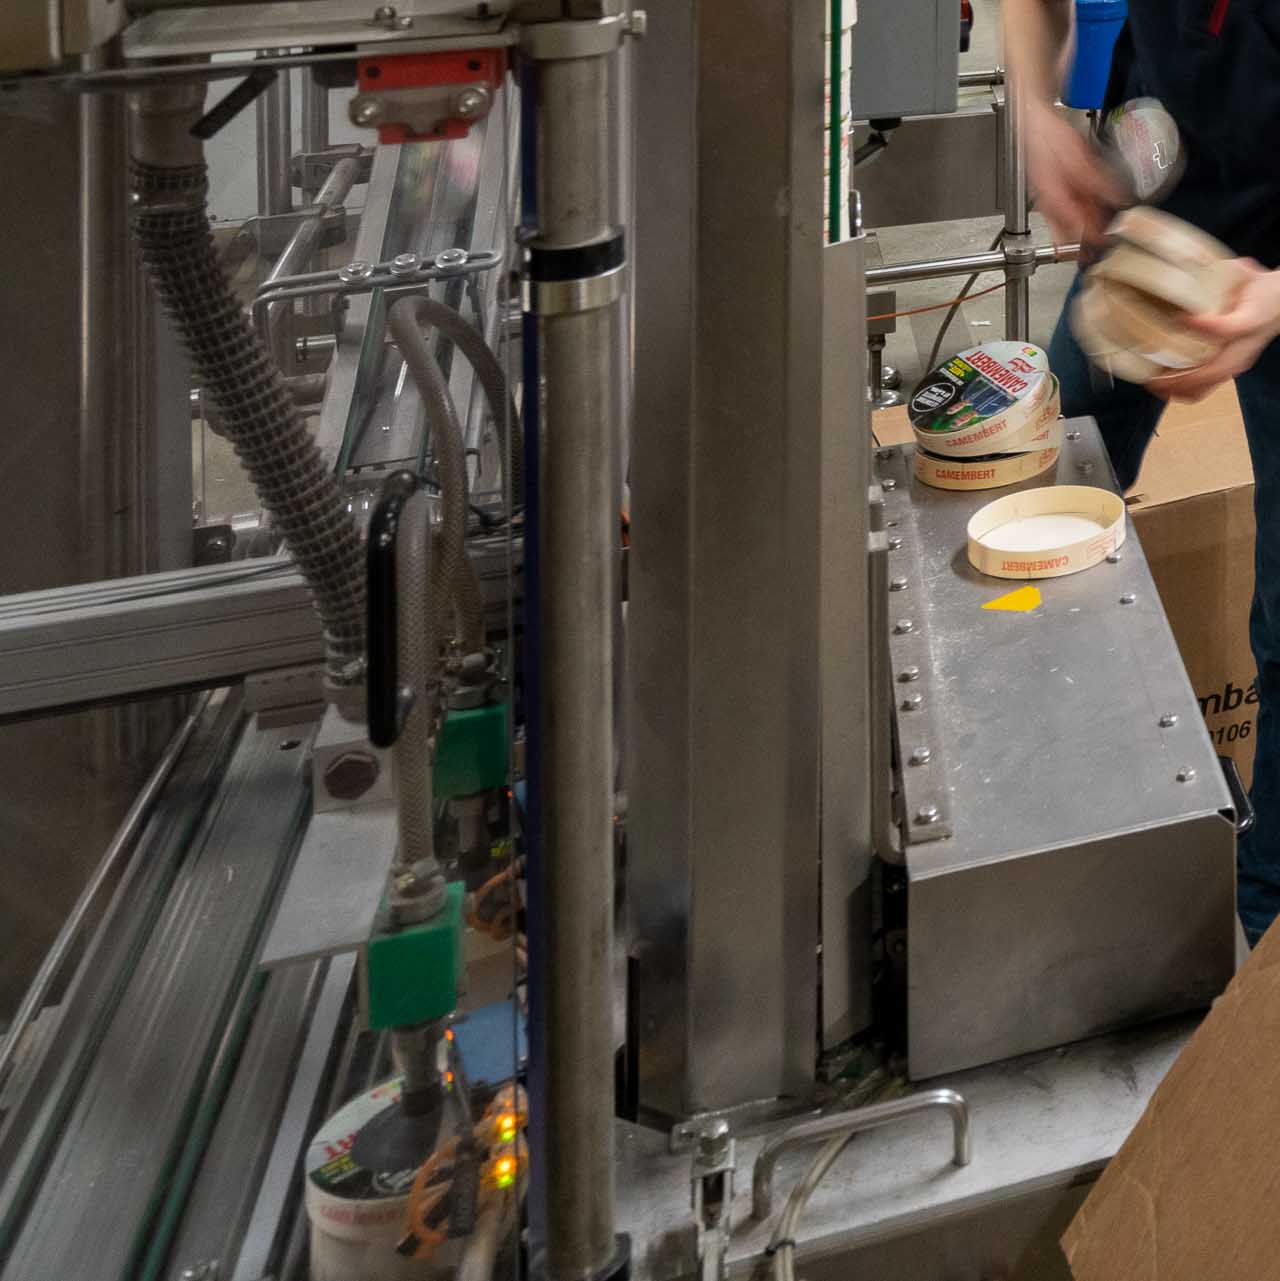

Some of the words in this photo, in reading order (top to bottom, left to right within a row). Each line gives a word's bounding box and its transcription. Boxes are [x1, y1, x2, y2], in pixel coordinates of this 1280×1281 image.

[966, 351, 1029, 393] CAMEMBERT
[944, 420, 1009, 447] CAMEMBERT
[935, 468, 996, 481] CAMEMBERT
[1001, 555, 1069, 573] CAMEMBERT
